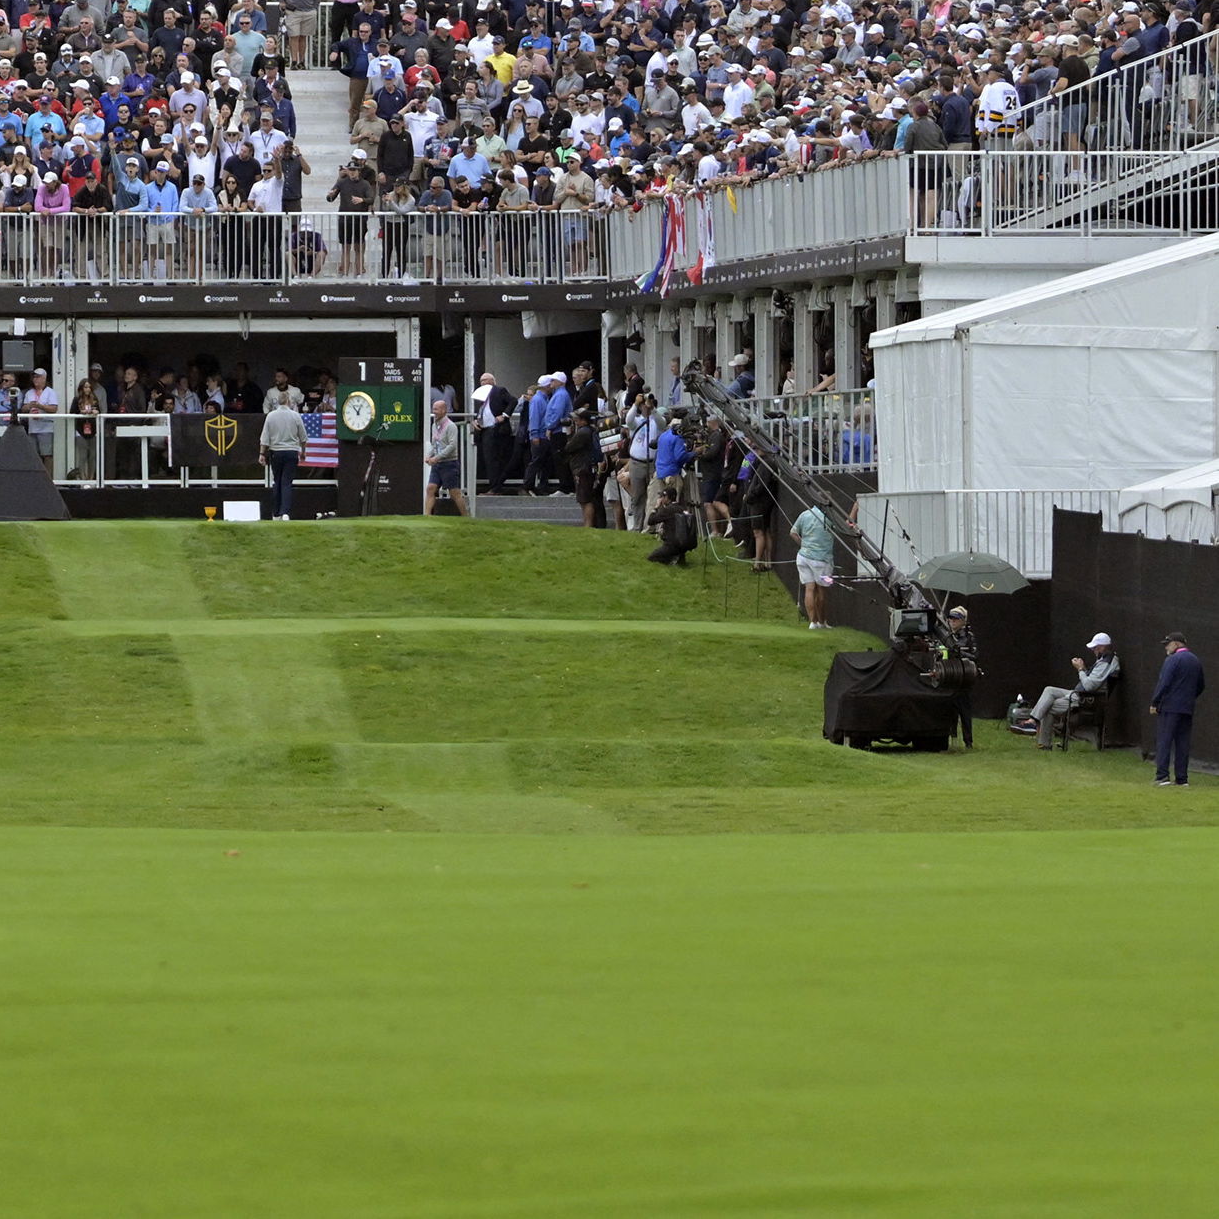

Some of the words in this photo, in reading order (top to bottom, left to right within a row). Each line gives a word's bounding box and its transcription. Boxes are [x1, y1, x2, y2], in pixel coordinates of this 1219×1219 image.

[27, 295, 53, 304] cognizant
[212, 295, 238, 304] cognizant
[394, 295, 420, 304] cognizant
[358, 362, 366, 381] 1
[383, 414, 412, 422] ROLEX
